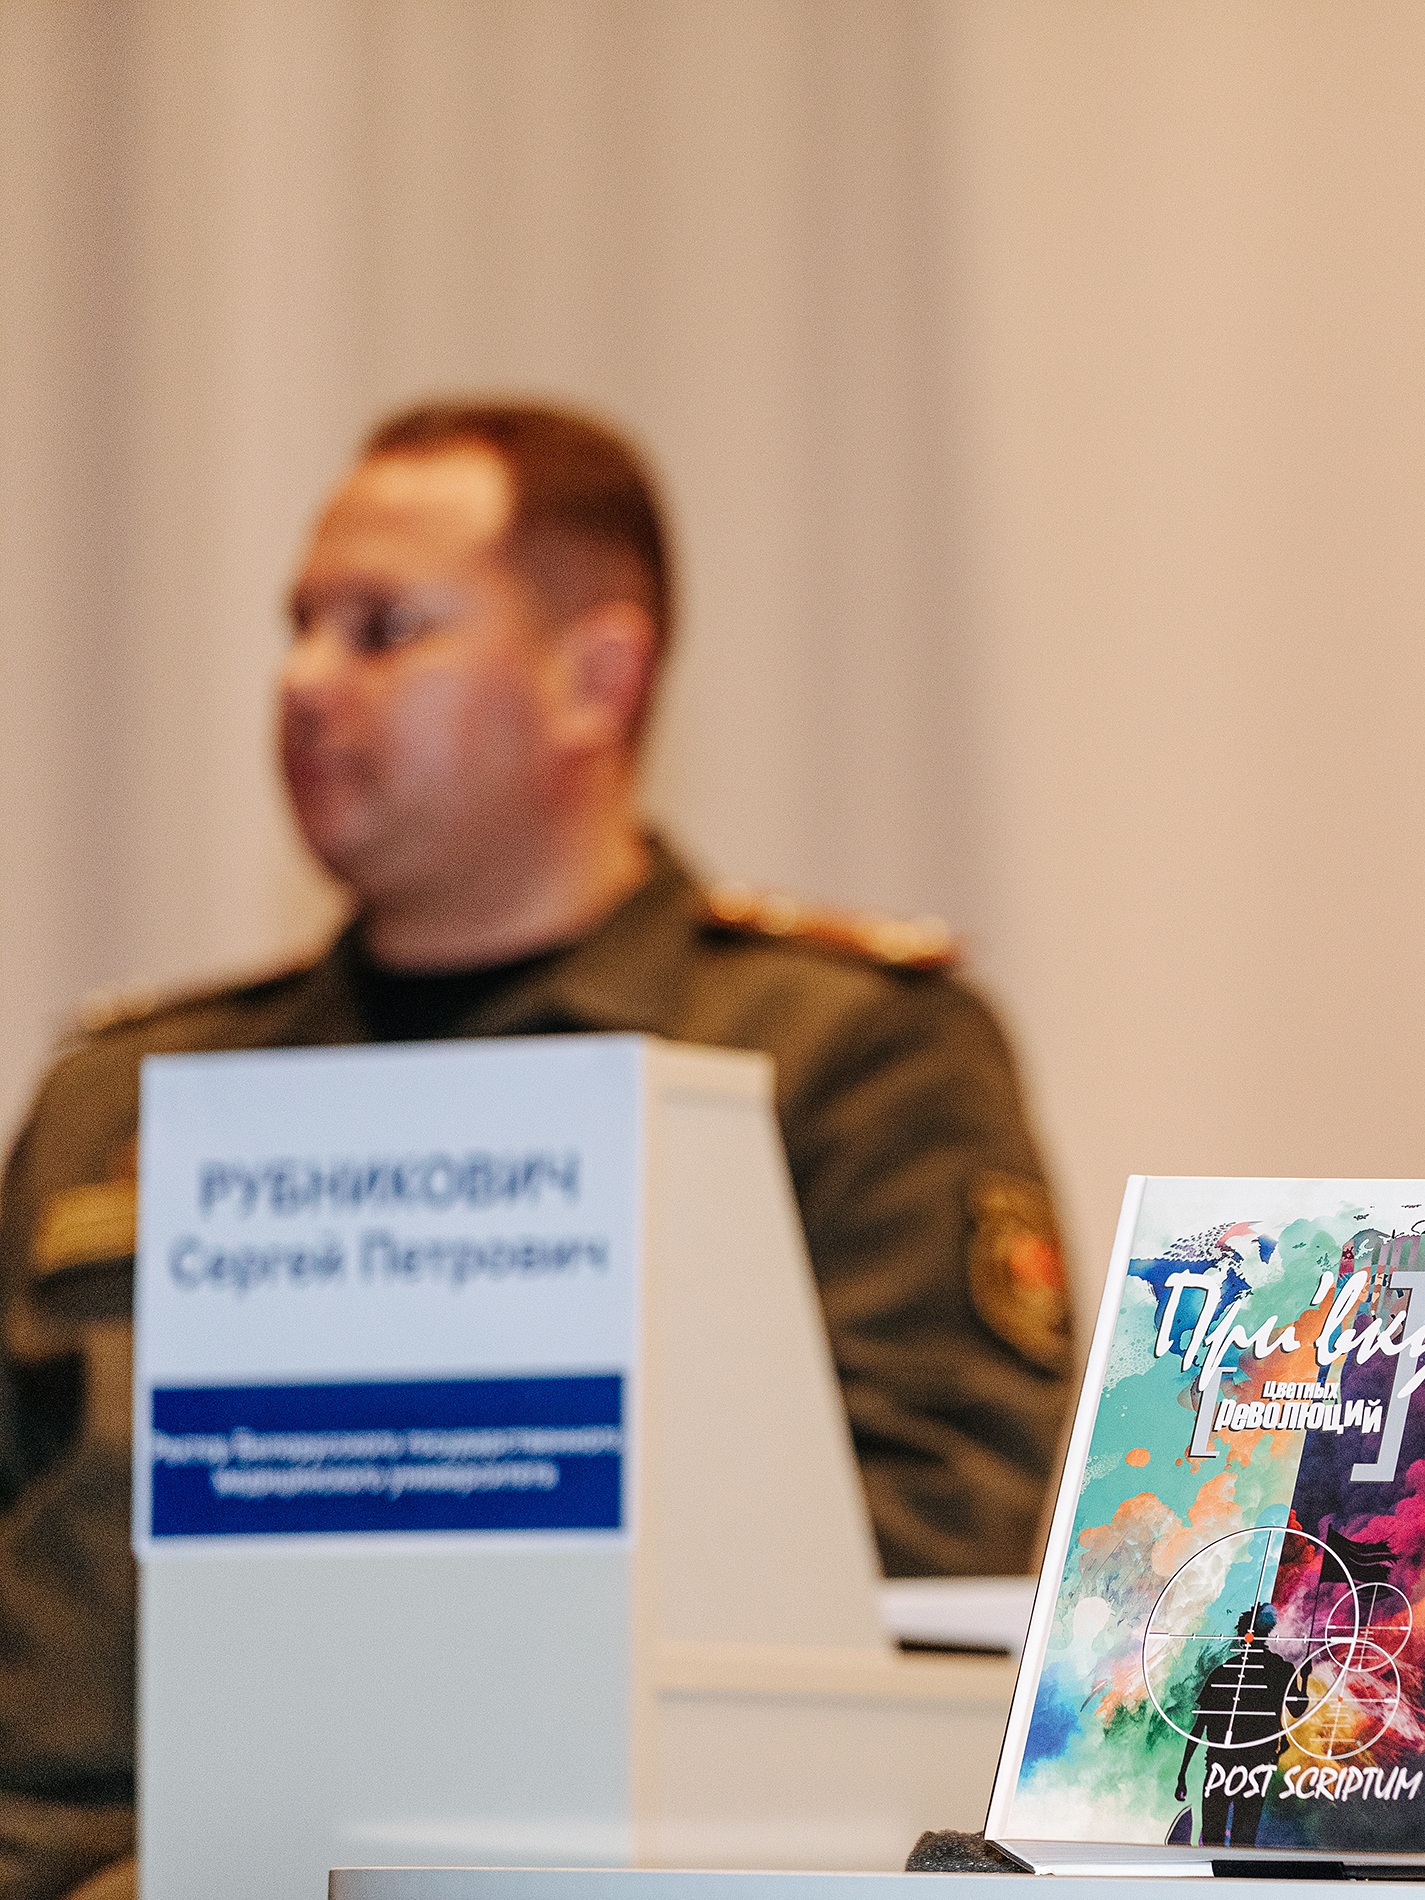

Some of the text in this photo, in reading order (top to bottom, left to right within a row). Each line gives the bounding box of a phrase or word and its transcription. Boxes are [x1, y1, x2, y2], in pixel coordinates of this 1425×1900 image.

[199, 1151, 582, 1216] РУБНИКОВИЧ
[168, 1228, 608, 1296] Сергей Петрович
[1205, 1762, 1424, 1801] POST SCRIPTUM
